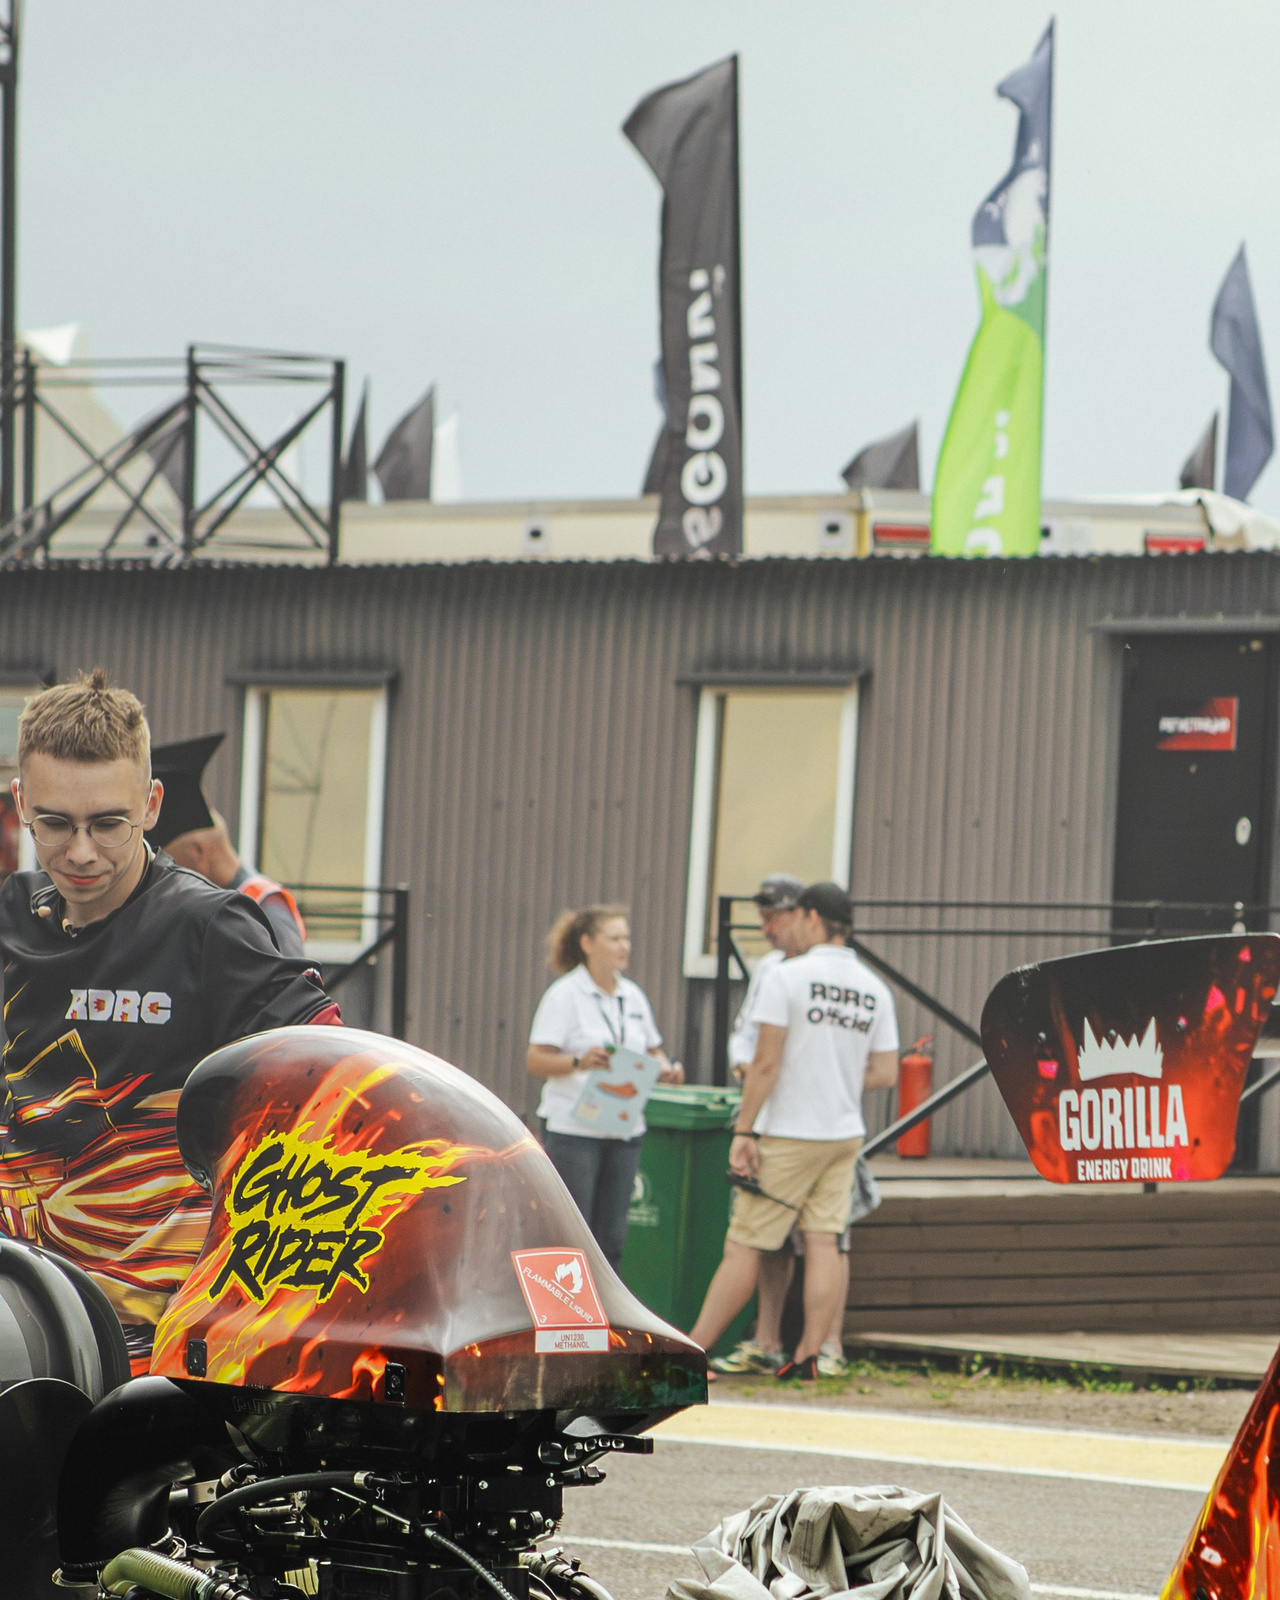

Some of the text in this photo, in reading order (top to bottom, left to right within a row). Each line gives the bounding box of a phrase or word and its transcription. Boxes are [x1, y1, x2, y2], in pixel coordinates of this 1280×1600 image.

[1058, 1084, 1189, 1151] GORILLA
[233, 1141, 420, 1230] GHOST
[1077, 1157, 1173, 1181] ENERGY DRINK
[208, 1218, 384, 1301] RIDER
[522, 1266, 594, 1324] FLAMMABLE LIQUID
[539, 1314, 548, 1324] 3
[560, 1333, 585, 1342] UN1230
[554, 1340, 590, 1350] METHANOL
